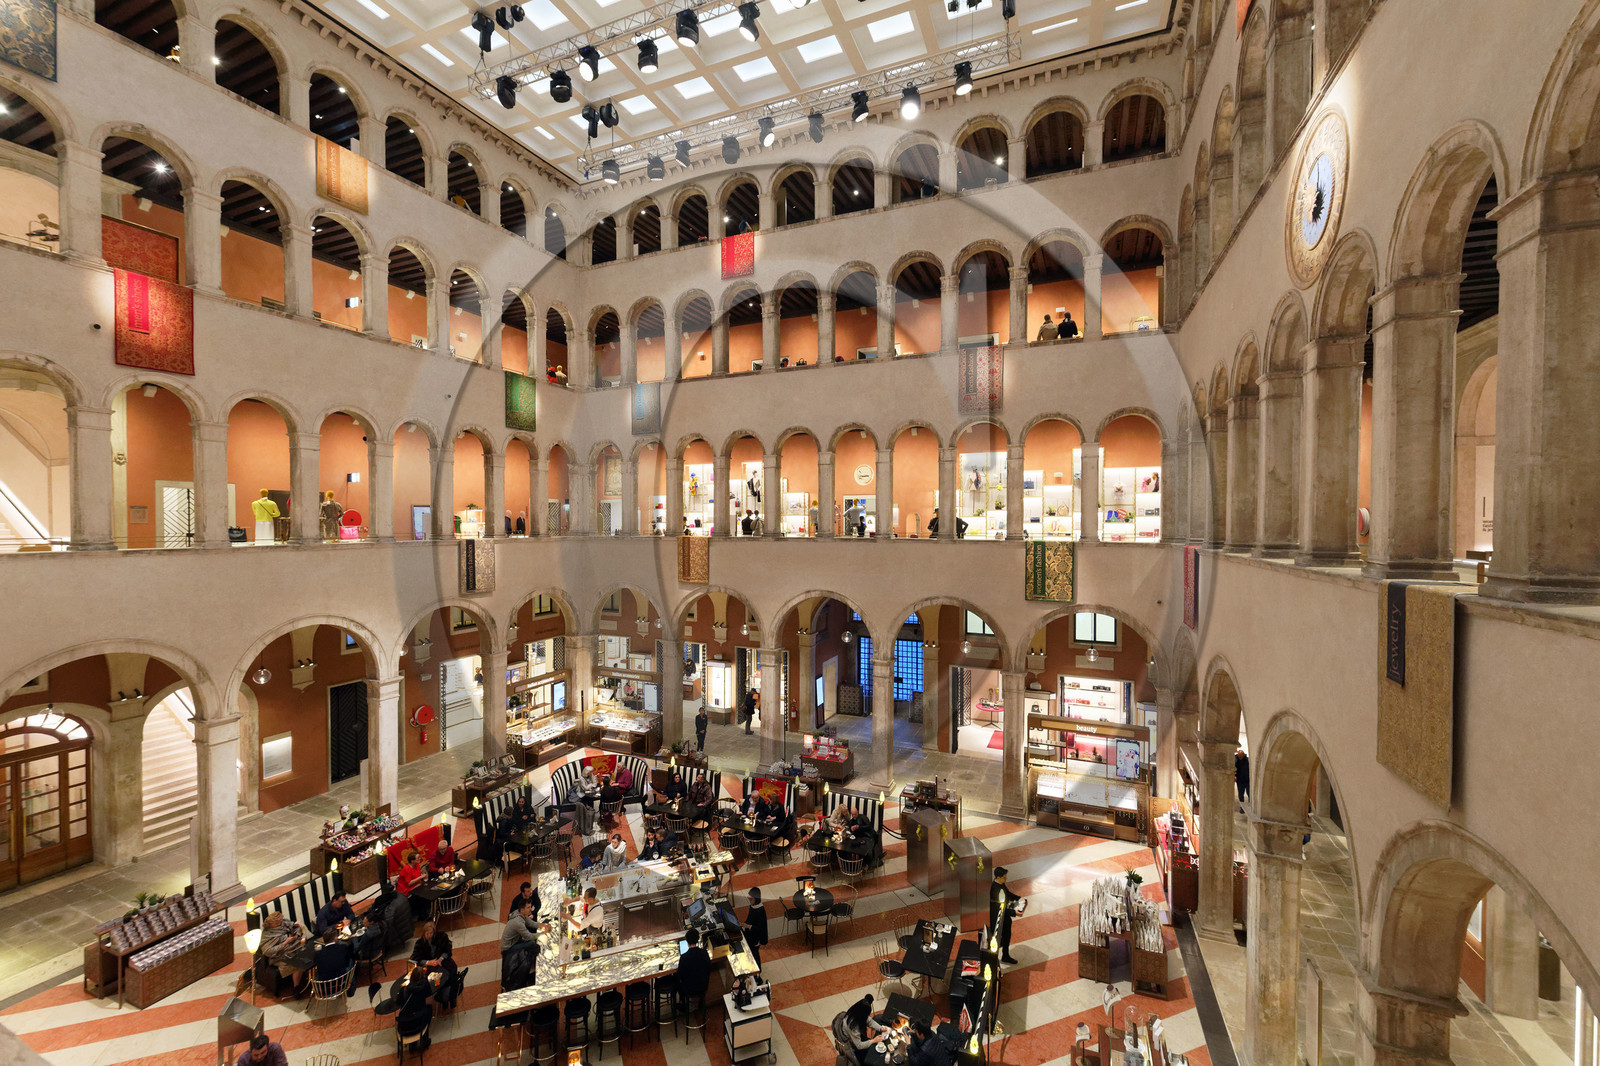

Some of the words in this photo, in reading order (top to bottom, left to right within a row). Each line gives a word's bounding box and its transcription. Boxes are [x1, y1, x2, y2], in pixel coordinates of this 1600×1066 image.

[132, 279, 143, 303] shoes
[132, 304, 143, 329] men's
[1389, 603, 1402, 676] jewelry
[1076, 724, 1098, 734] beauty
